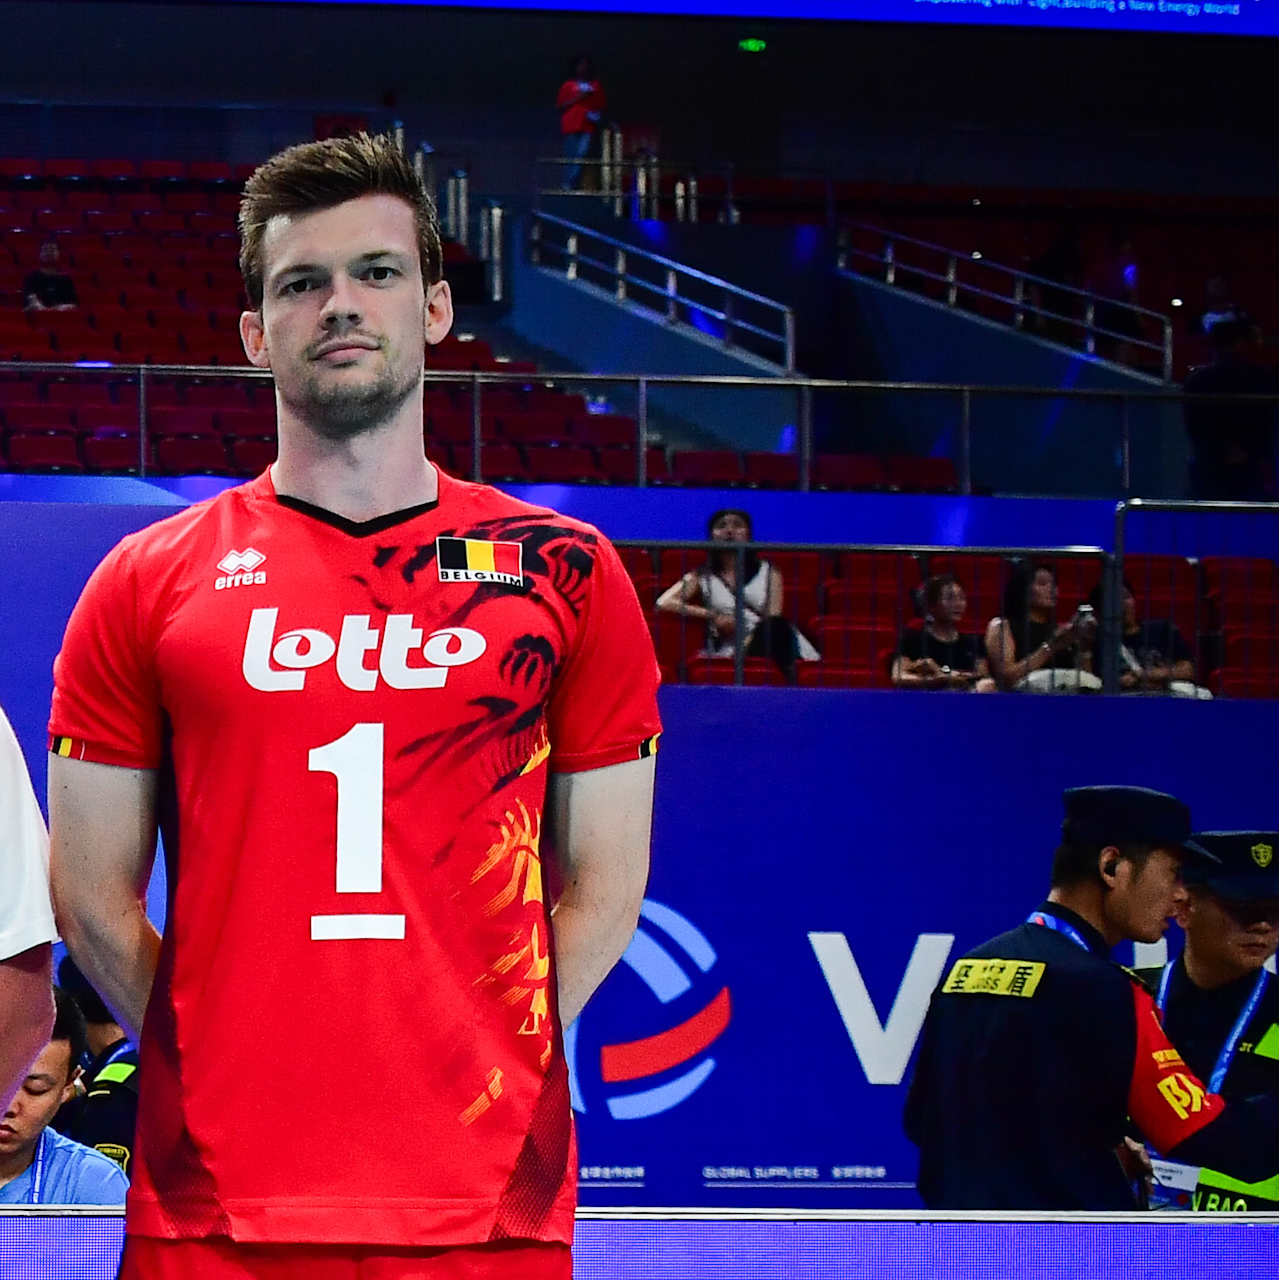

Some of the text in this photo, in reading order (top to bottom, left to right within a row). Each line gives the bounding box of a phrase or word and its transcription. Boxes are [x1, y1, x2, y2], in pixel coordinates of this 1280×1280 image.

[1158, 1, 1200, 16] Energy
[440, 570, 521, 588] BELGIUM
[308, 723, 384, 893] 1
